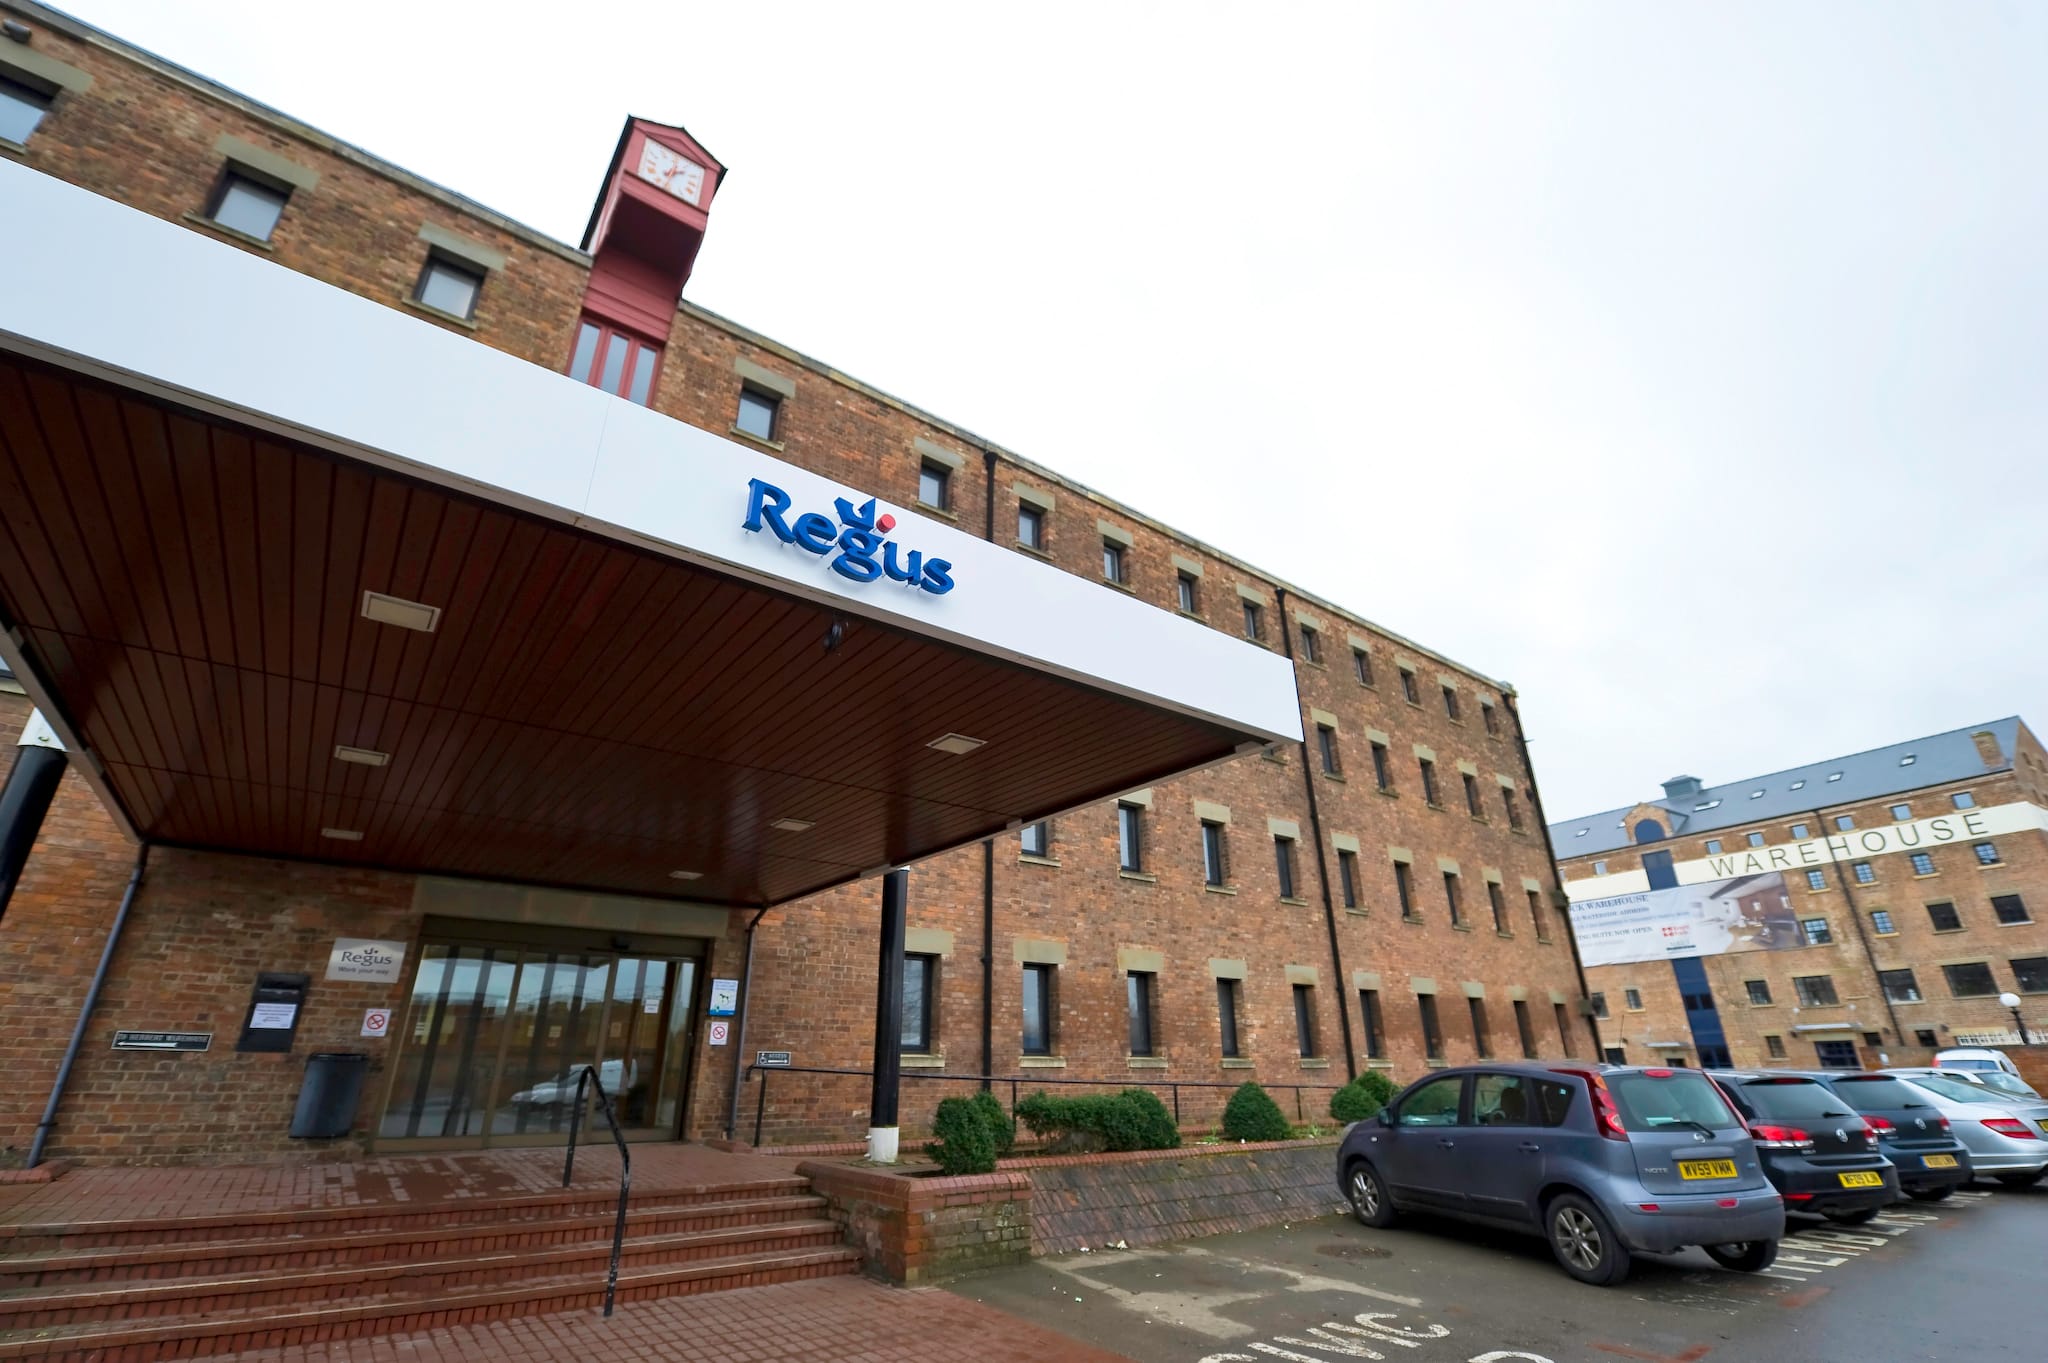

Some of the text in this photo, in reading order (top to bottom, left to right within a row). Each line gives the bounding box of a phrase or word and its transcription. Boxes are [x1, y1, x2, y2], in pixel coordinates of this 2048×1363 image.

[742, 478, 955, 595] Regus
[1709, 812, 1989, 877] WAREHOUSE
[1586, 895, 1649, 910] WAREHOUSE
[341, 947, 393, 967] Regus
